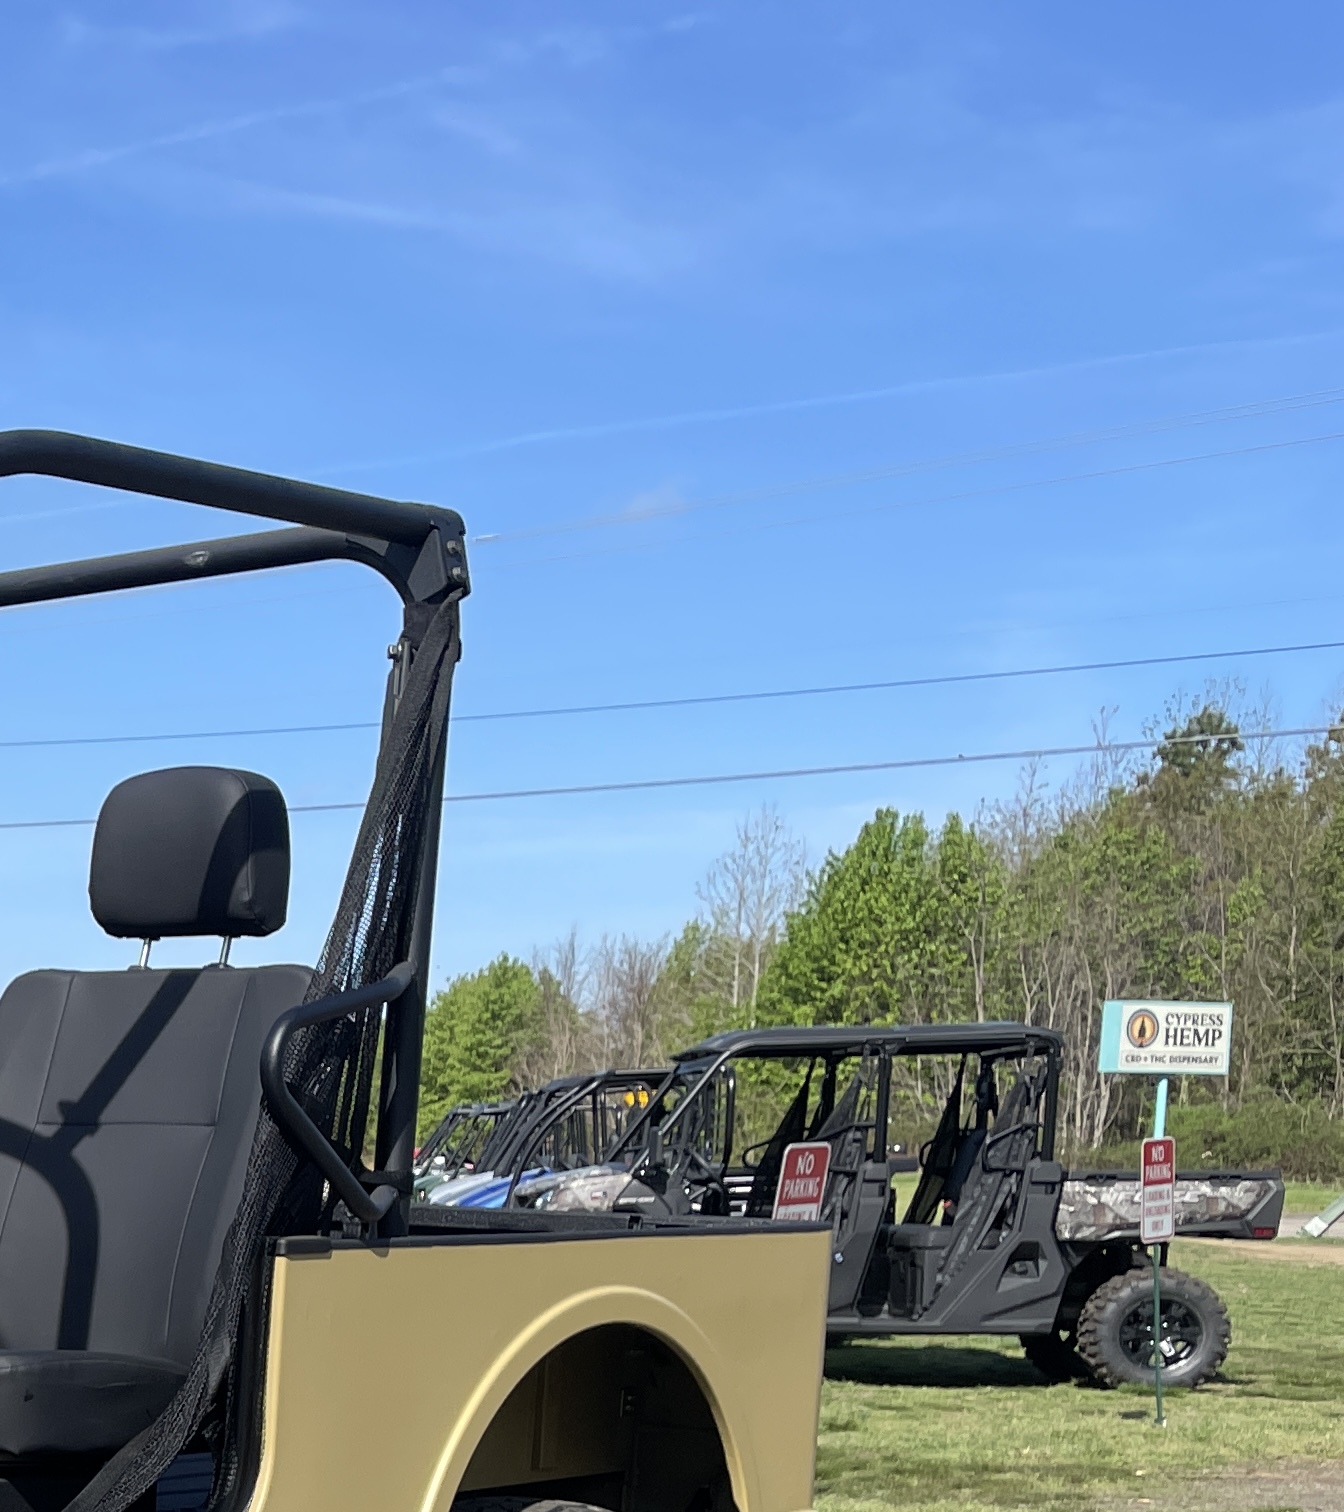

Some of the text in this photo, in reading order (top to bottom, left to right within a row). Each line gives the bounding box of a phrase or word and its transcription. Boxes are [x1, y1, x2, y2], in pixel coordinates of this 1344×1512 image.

[1165, 1012, 1224, 1026] CYPRESS
[1164, 1027, 1223, 1047] HEMP
[1150, 1054, 1166, 1064] THC
[1151, 1144, 1165, 1162] NO
[795, 1151, 815, 1176] NO
[782, 1176, 821, 1200] PARKING
